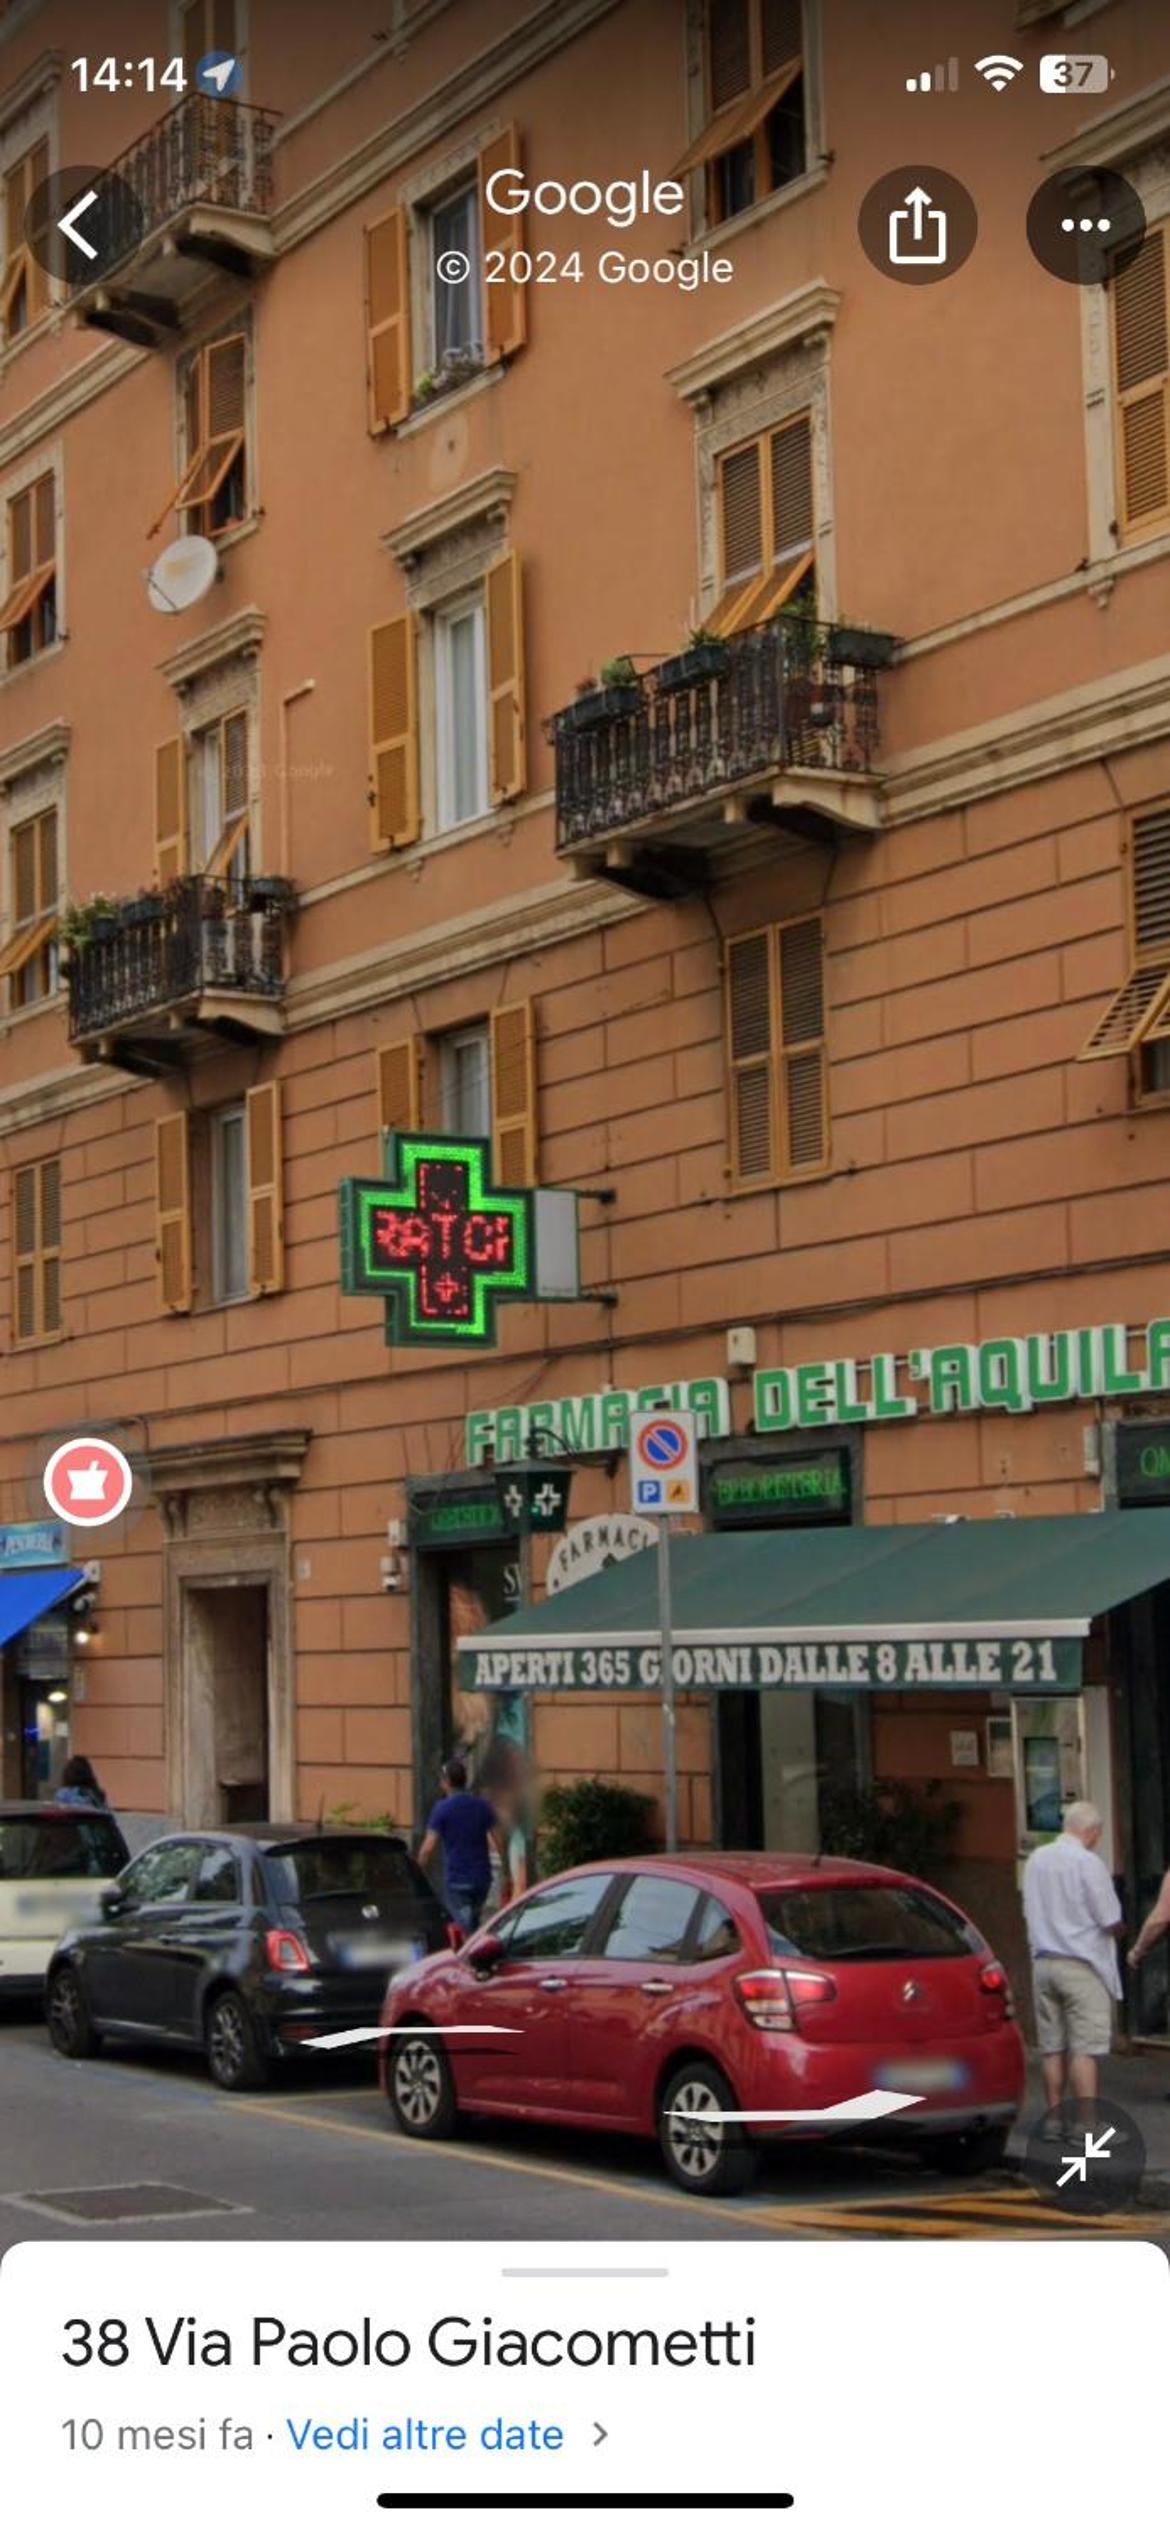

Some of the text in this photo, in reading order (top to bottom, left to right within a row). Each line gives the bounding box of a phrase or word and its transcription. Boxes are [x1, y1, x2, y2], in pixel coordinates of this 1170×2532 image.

[643, 1483, 657, 1501] P
[474, 1641, 1056, 1685] APERTI 365 GORNI DALLE 8 ALLE 21
